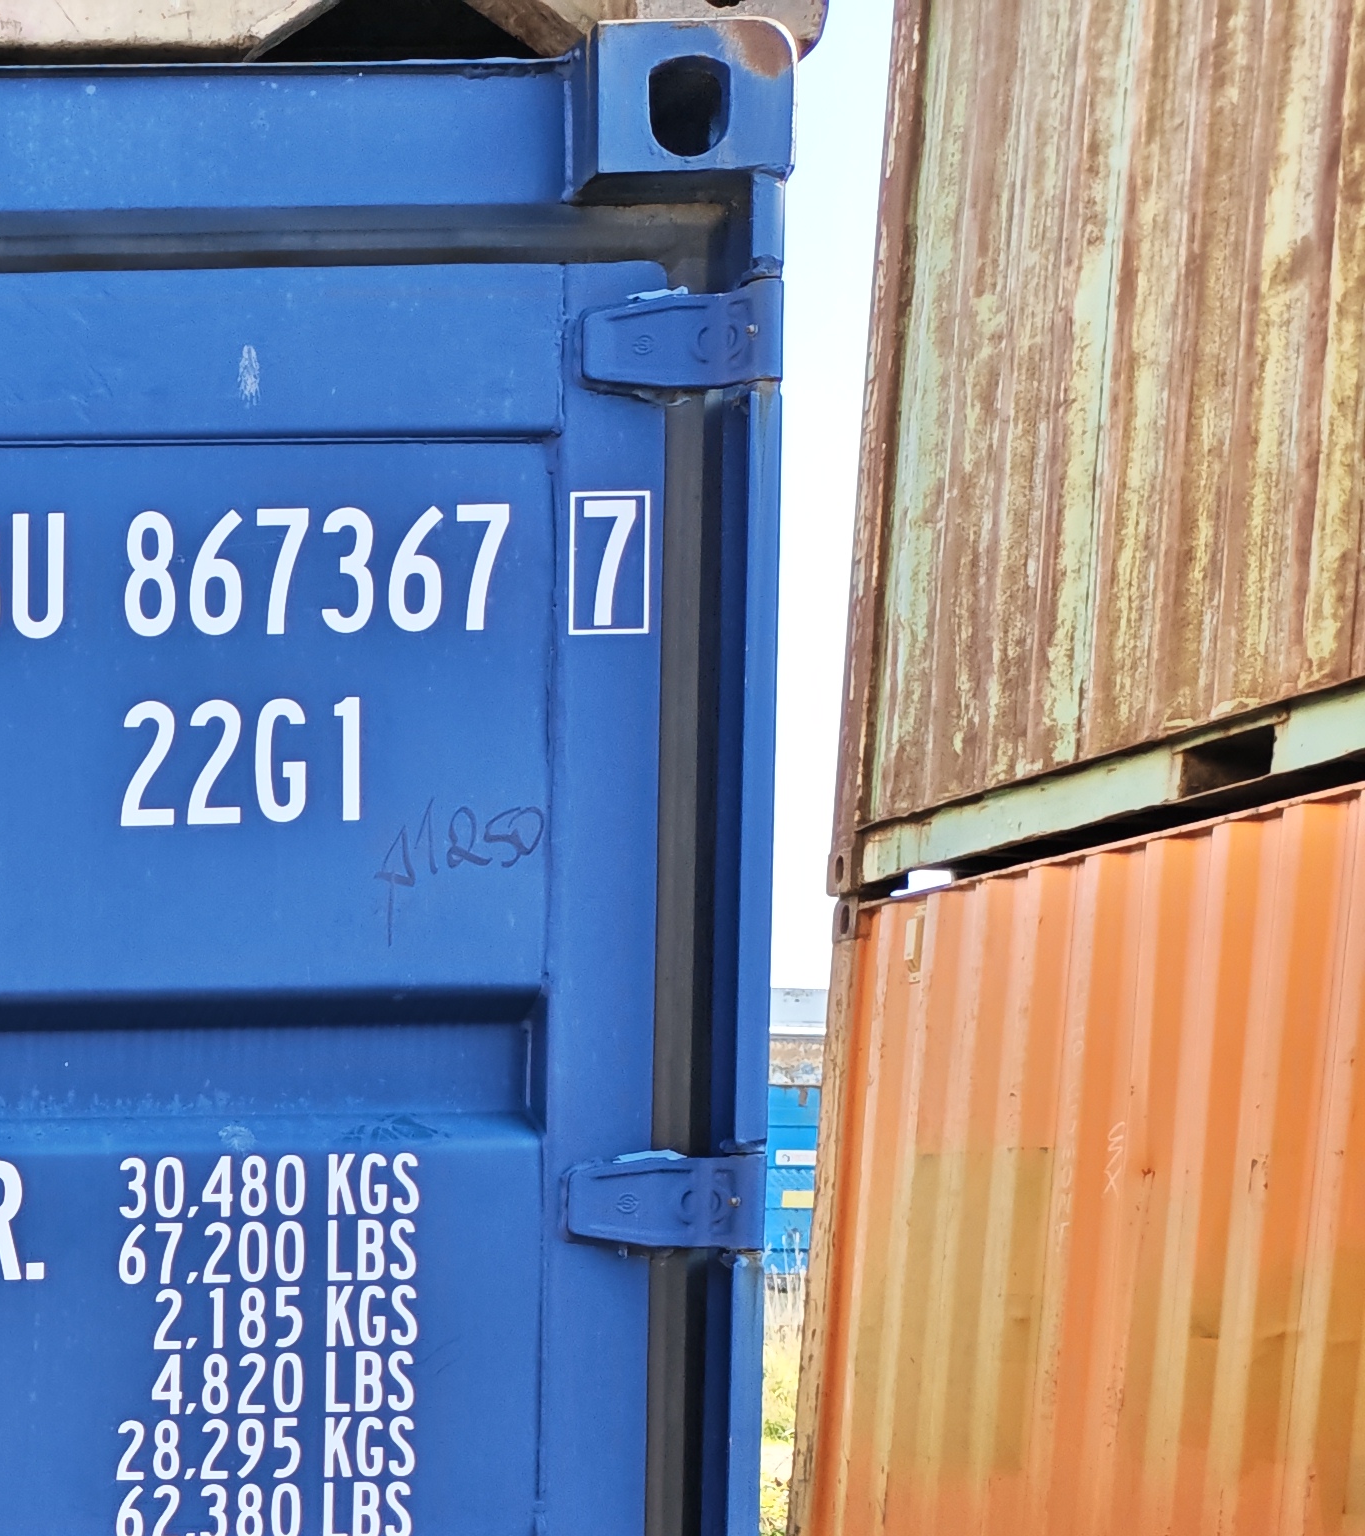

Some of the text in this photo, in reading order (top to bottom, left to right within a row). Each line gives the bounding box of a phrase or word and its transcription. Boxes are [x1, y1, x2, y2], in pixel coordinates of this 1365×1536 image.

[124, 503, 510, 637] 867367
[583, 499, 637, 627] 7
[120, 696, 361, 827] 22G1
[119, 1153, 420, 1218] 30,480 KGS
[118, 1219, 417, 1284] 67,200 LBS
[153, 1285, 419, 1349] 2,185 KGS
[151, 1351, 414, 1414] 4,820 LBS
[116, 1416, 416, 1481] 28,295 KGS
